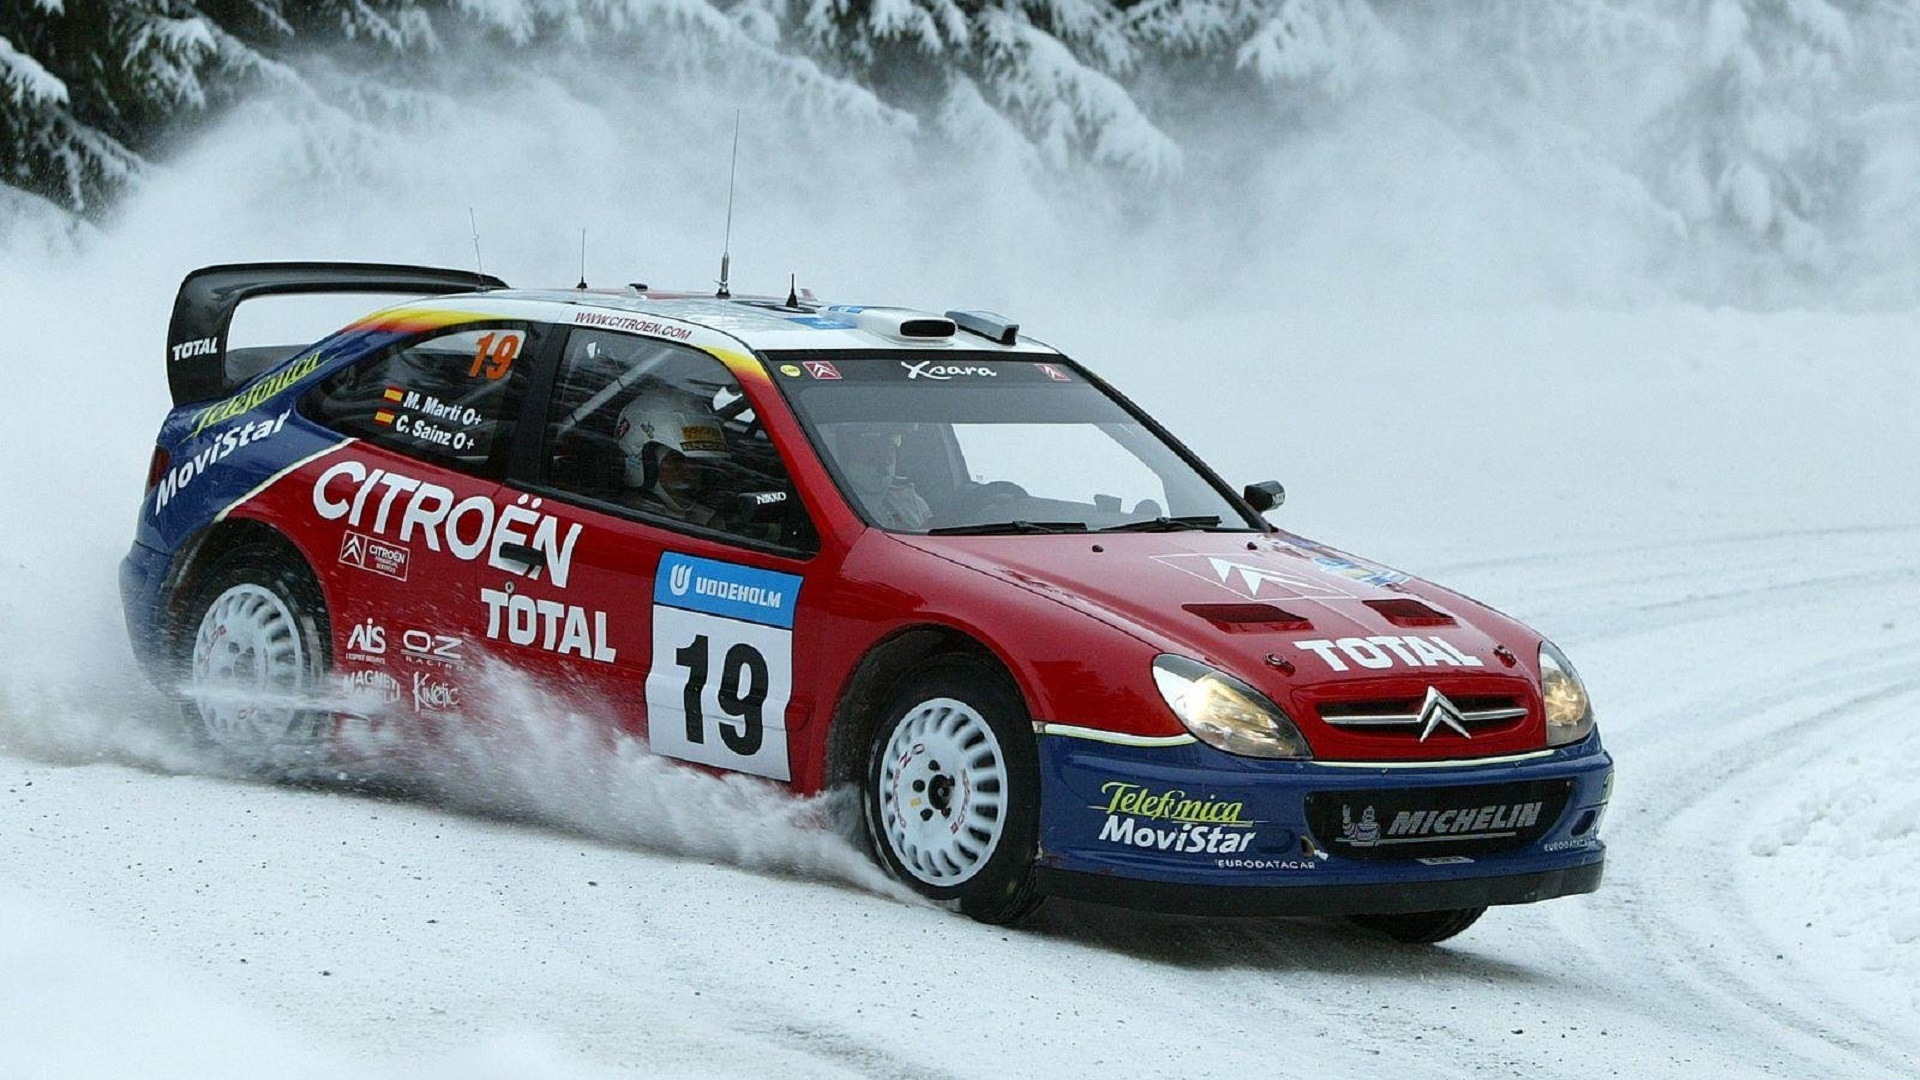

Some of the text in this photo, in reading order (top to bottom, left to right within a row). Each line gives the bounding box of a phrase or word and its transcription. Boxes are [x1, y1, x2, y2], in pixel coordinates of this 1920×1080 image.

[575, 312, 692, 340] WWW.CITROEN.COM
[172, 336, 218, 361] TOTAL
[468, 332, 519, 380] 19
[900, 361, 997, 379] Xsara
[403, 391, 421, 410] M.
[422, 396, 463, 421] Marti
[396, 415, 410, 433] C.
[412, 420, 452, 446] Sainz
[155, 408, 292, 517] MoviStar
[313, 461, 583, 588] CITROËN
[695, 576, 782, 608] UDDEHOLM
[481, 587, 617, 663] TOTAL
[1292, 635, 1484, 672] TOTAL
[676, 634, 769, 756] 19
[1099, 814, 1256, 854] MoviStar
[1387, 801, 1543, 835] MICHELIN
[1217, 859, 1316, 870] EURODATACAR
